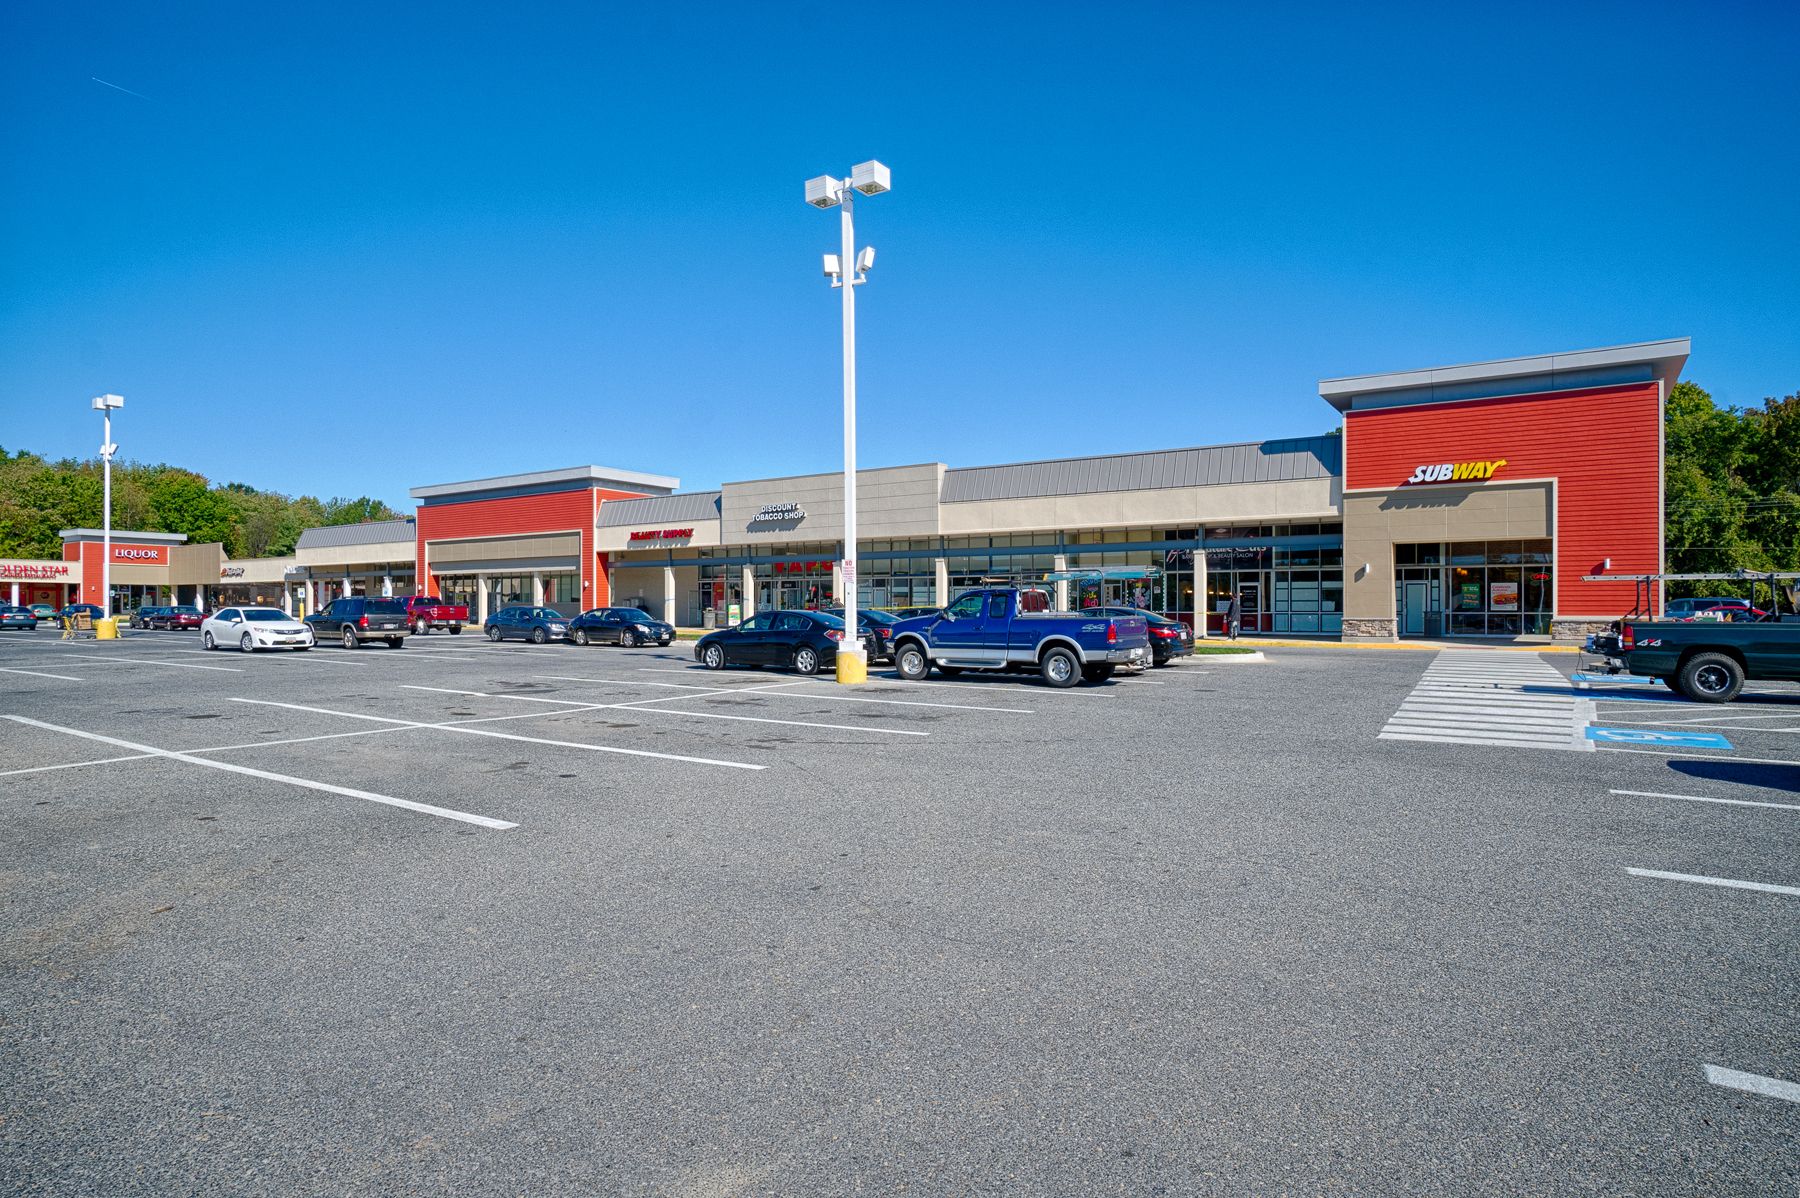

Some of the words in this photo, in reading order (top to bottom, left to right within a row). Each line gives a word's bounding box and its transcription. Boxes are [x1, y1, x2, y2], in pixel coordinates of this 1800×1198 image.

[1408, 459, 1507, 483] SUBWAY
[761, 503, 797, 512] DISCOUNT
[752, 512, 783, 521] TOBACCO
[784, 511, 804, 520] SHOP
[630, 531, 662, 540] BEAUTY
[662, 528, 695, 539] SUPPLY
[115, 549, 158, 559] LIQUOR
[41, 565, 69, 575] STAR
